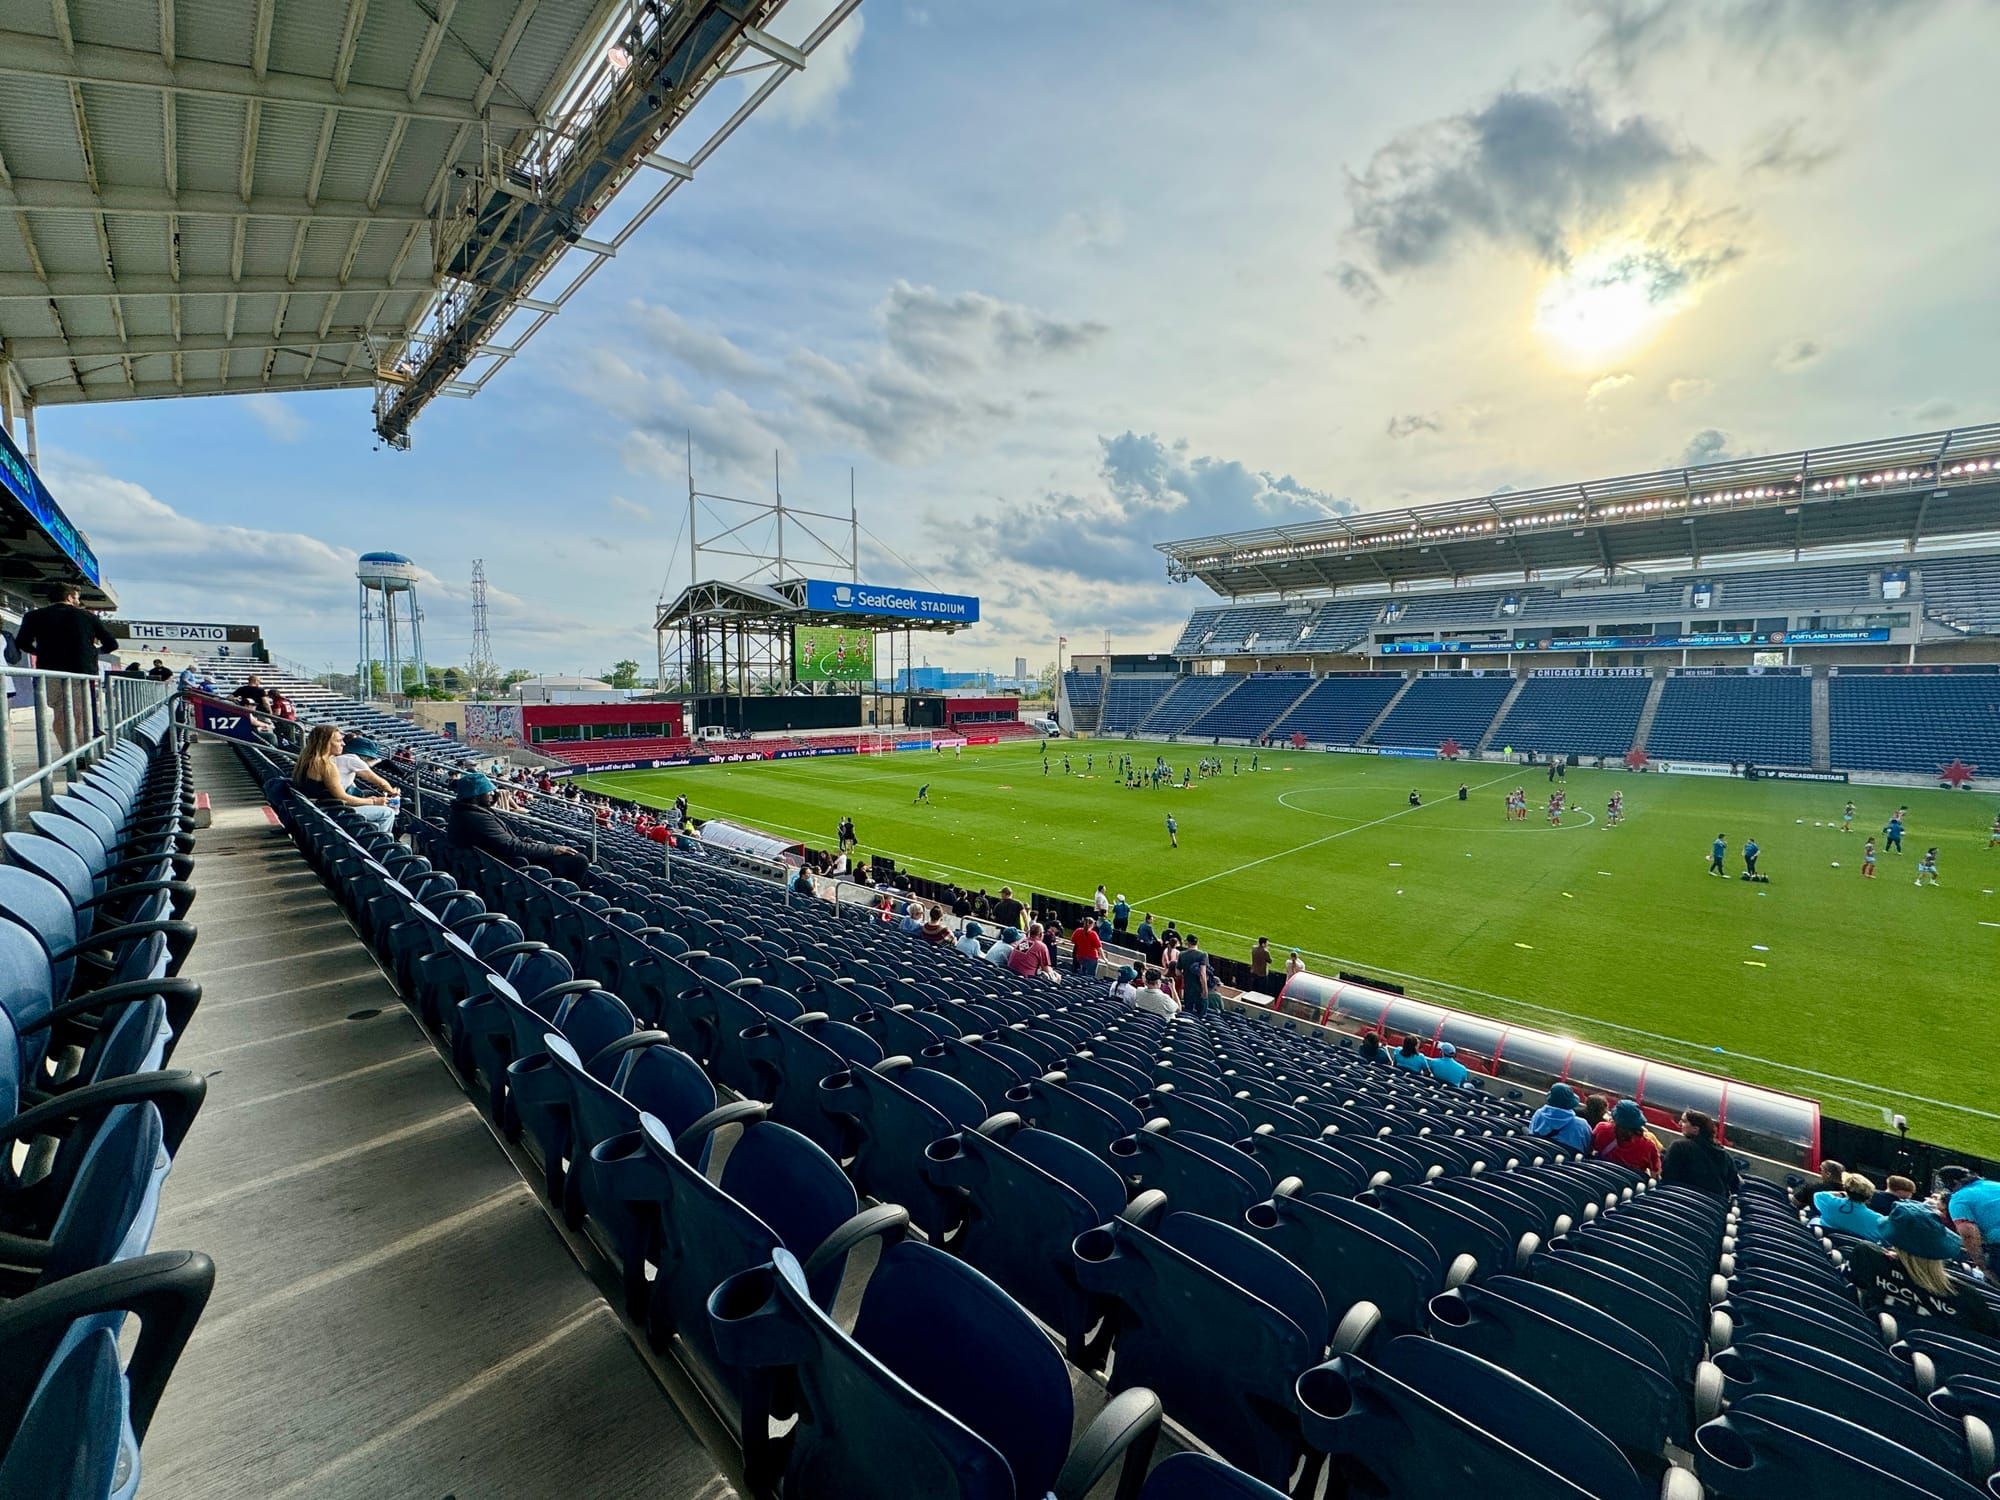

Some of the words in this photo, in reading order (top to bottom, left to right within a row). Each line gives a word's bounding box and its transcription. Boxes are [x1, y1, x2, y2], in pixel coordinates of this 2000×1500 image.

[858, 591, 917, 610] SeatGeek
[921, 601, 965, 614] STADIUM
[133, 625, 164, 637] THE
[181, 627, 223, 639] PATIO
[1537, 669, 1581, 677] CHICAGO
[1584, 669, 1604, 677] RED
[1607, 668, 1642, 677] STARS
[209, 717, 241, 730] 127
[660, 759, 690, 767] Nationwide
[709, 755, 725, 764] ally
[728, 753, 744, 762] ally
[746, 752, 762, 761] ally
[622, 762, 636, 771] pitch
[1778, 771, 1845, 781] @CHICAGOREDSTARS
[1876, 1275, 1957, 1315] HOCNG
